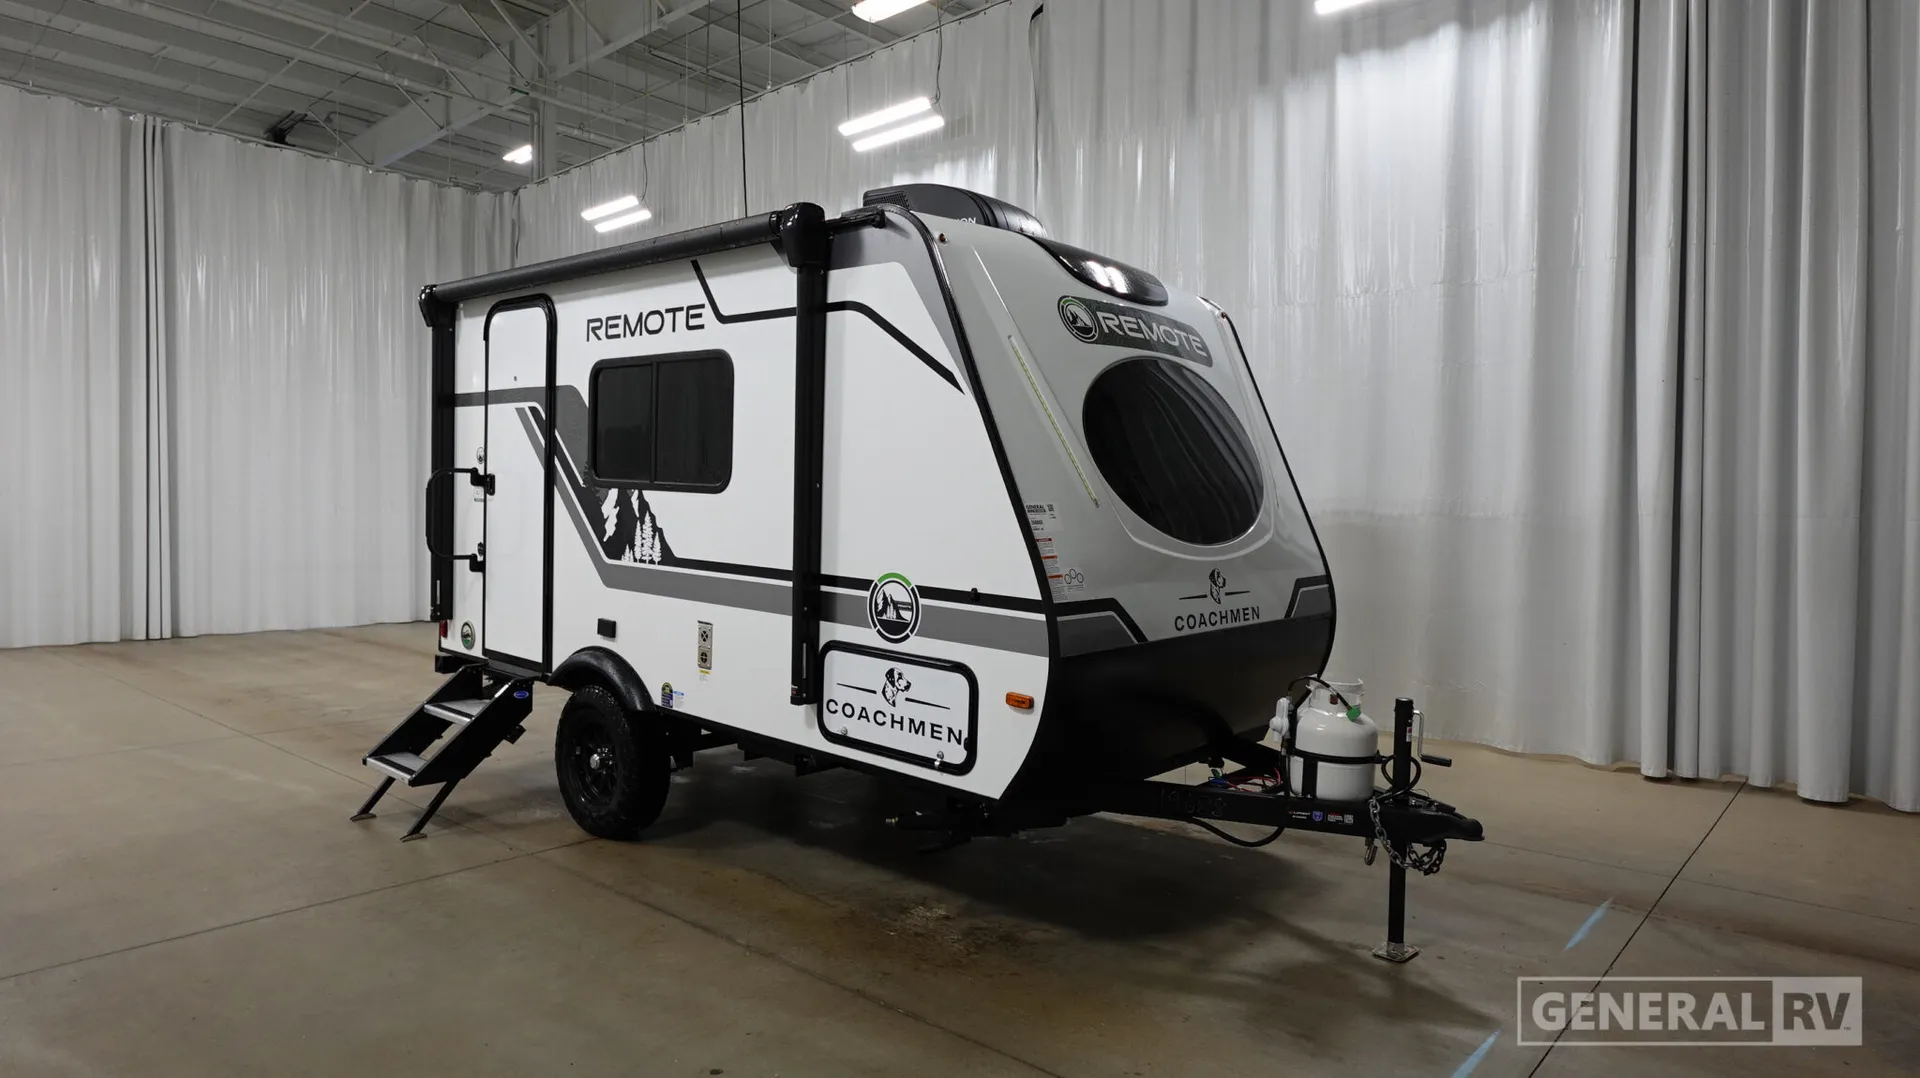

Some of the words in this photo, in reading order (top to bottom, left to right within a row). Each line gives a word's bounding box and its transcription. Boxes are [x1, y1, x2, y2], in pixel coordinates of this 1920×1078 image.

[586, 303, 706, 342] REMOTE
[1096, 311, 1208, 357] REMOTE
[1174, 606, 1260, 631] COACHMEN
[826, 699, 963, 745] COACHMEN
